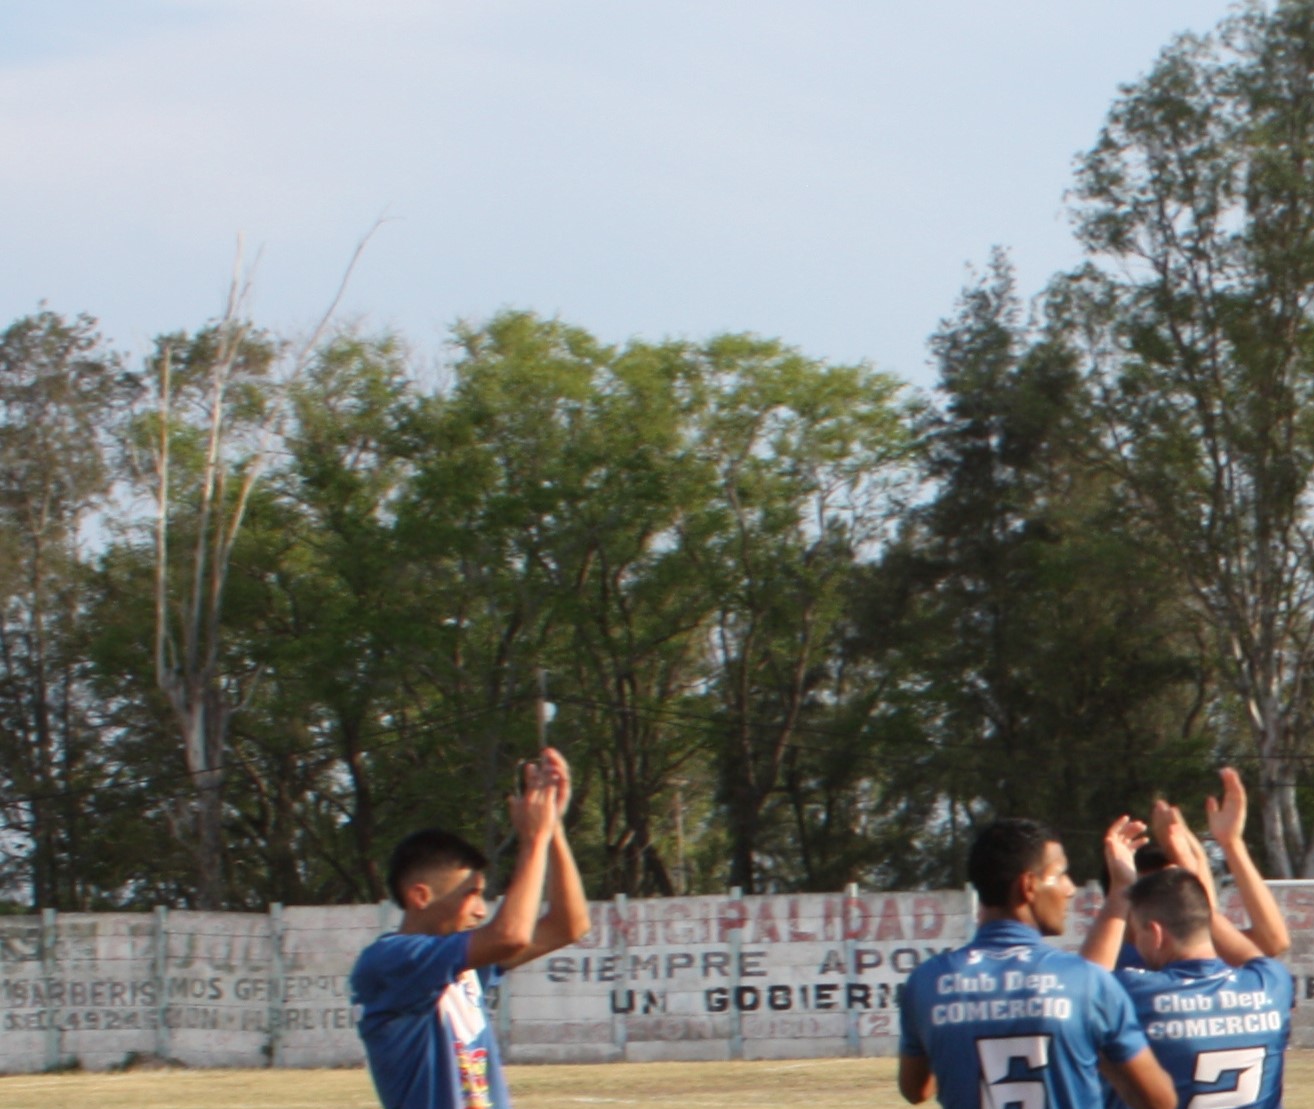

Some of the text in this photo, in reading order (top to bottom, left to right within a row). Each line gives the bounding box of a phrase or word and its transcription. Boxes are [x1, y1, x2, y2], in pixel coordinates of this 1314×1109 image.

[576, 896, 946, 949] UNICIPALIDAD
[546, 949, 768, 983] SIEMPRE
[937, 970, 1065, 995] Club Dep.
[610, 984, 906, 1014] UN GOBIERN
[932, 998, 1071, 1026] COMERCIO
[1154, 988, 1273, 1014] Club Dep.
[1147, 1010, 1281, 1039] COMERCIO
